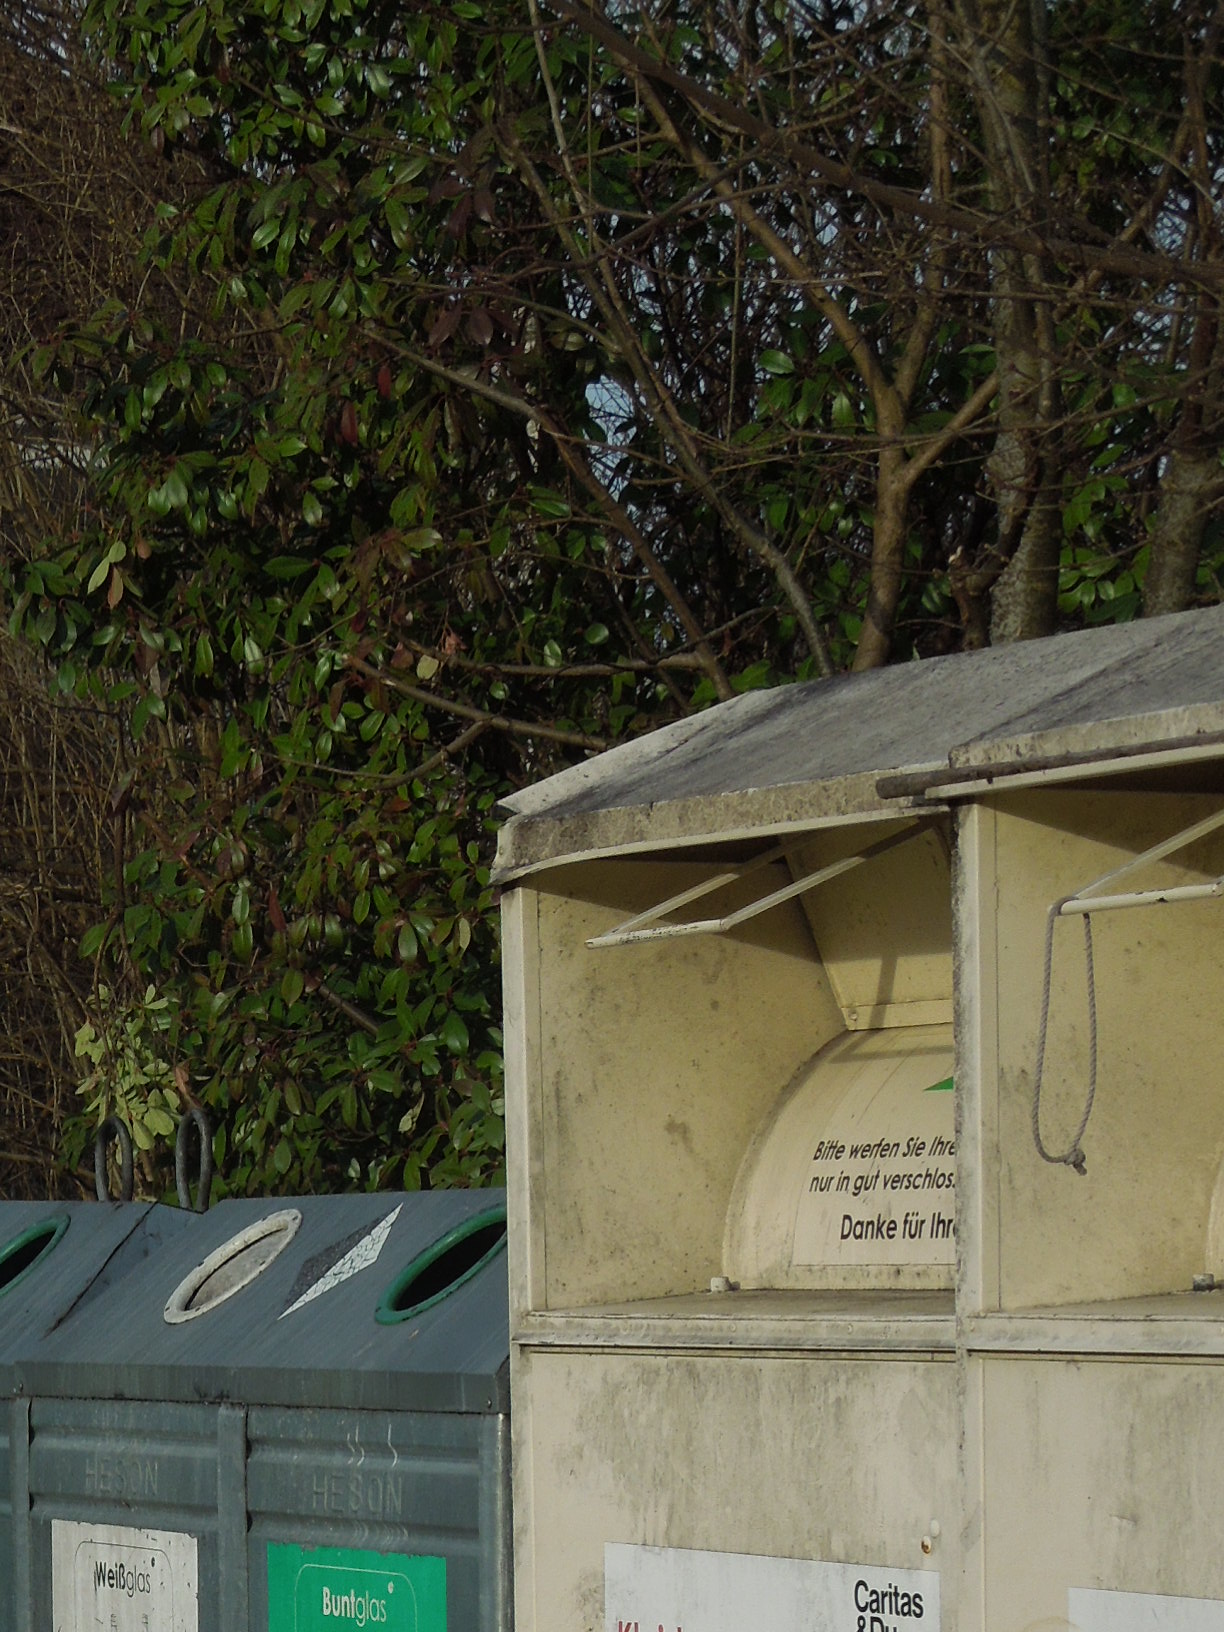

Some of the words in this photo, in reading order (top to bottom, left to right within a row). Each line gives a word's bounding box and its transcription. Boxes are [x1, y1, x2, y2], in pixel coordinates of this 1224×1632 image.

[813, 1140, 845, 1160] Bitte
[849, 1138, 900, 1159] werfen
[902, 1136, 926, 1157] Sie
[809, 1175, 835, 1192] nur
[836, 1170, 850, 1191] in
[852, 1169, 880, 1197] gut
[883, 1168, 956, 1190] verschlos
[840, 1213, 897, 1240] Danke
[902, 1211, 926, 1240] für
[86, 1456, 159, 1496] HESON
[313, 1472, 402, 1515] HESON
[95, 1560, 152, 1598] Weißglas
[322, 1586, 387, 1627] Buntglas
[854, 1580, 924, 1619] Caritas
